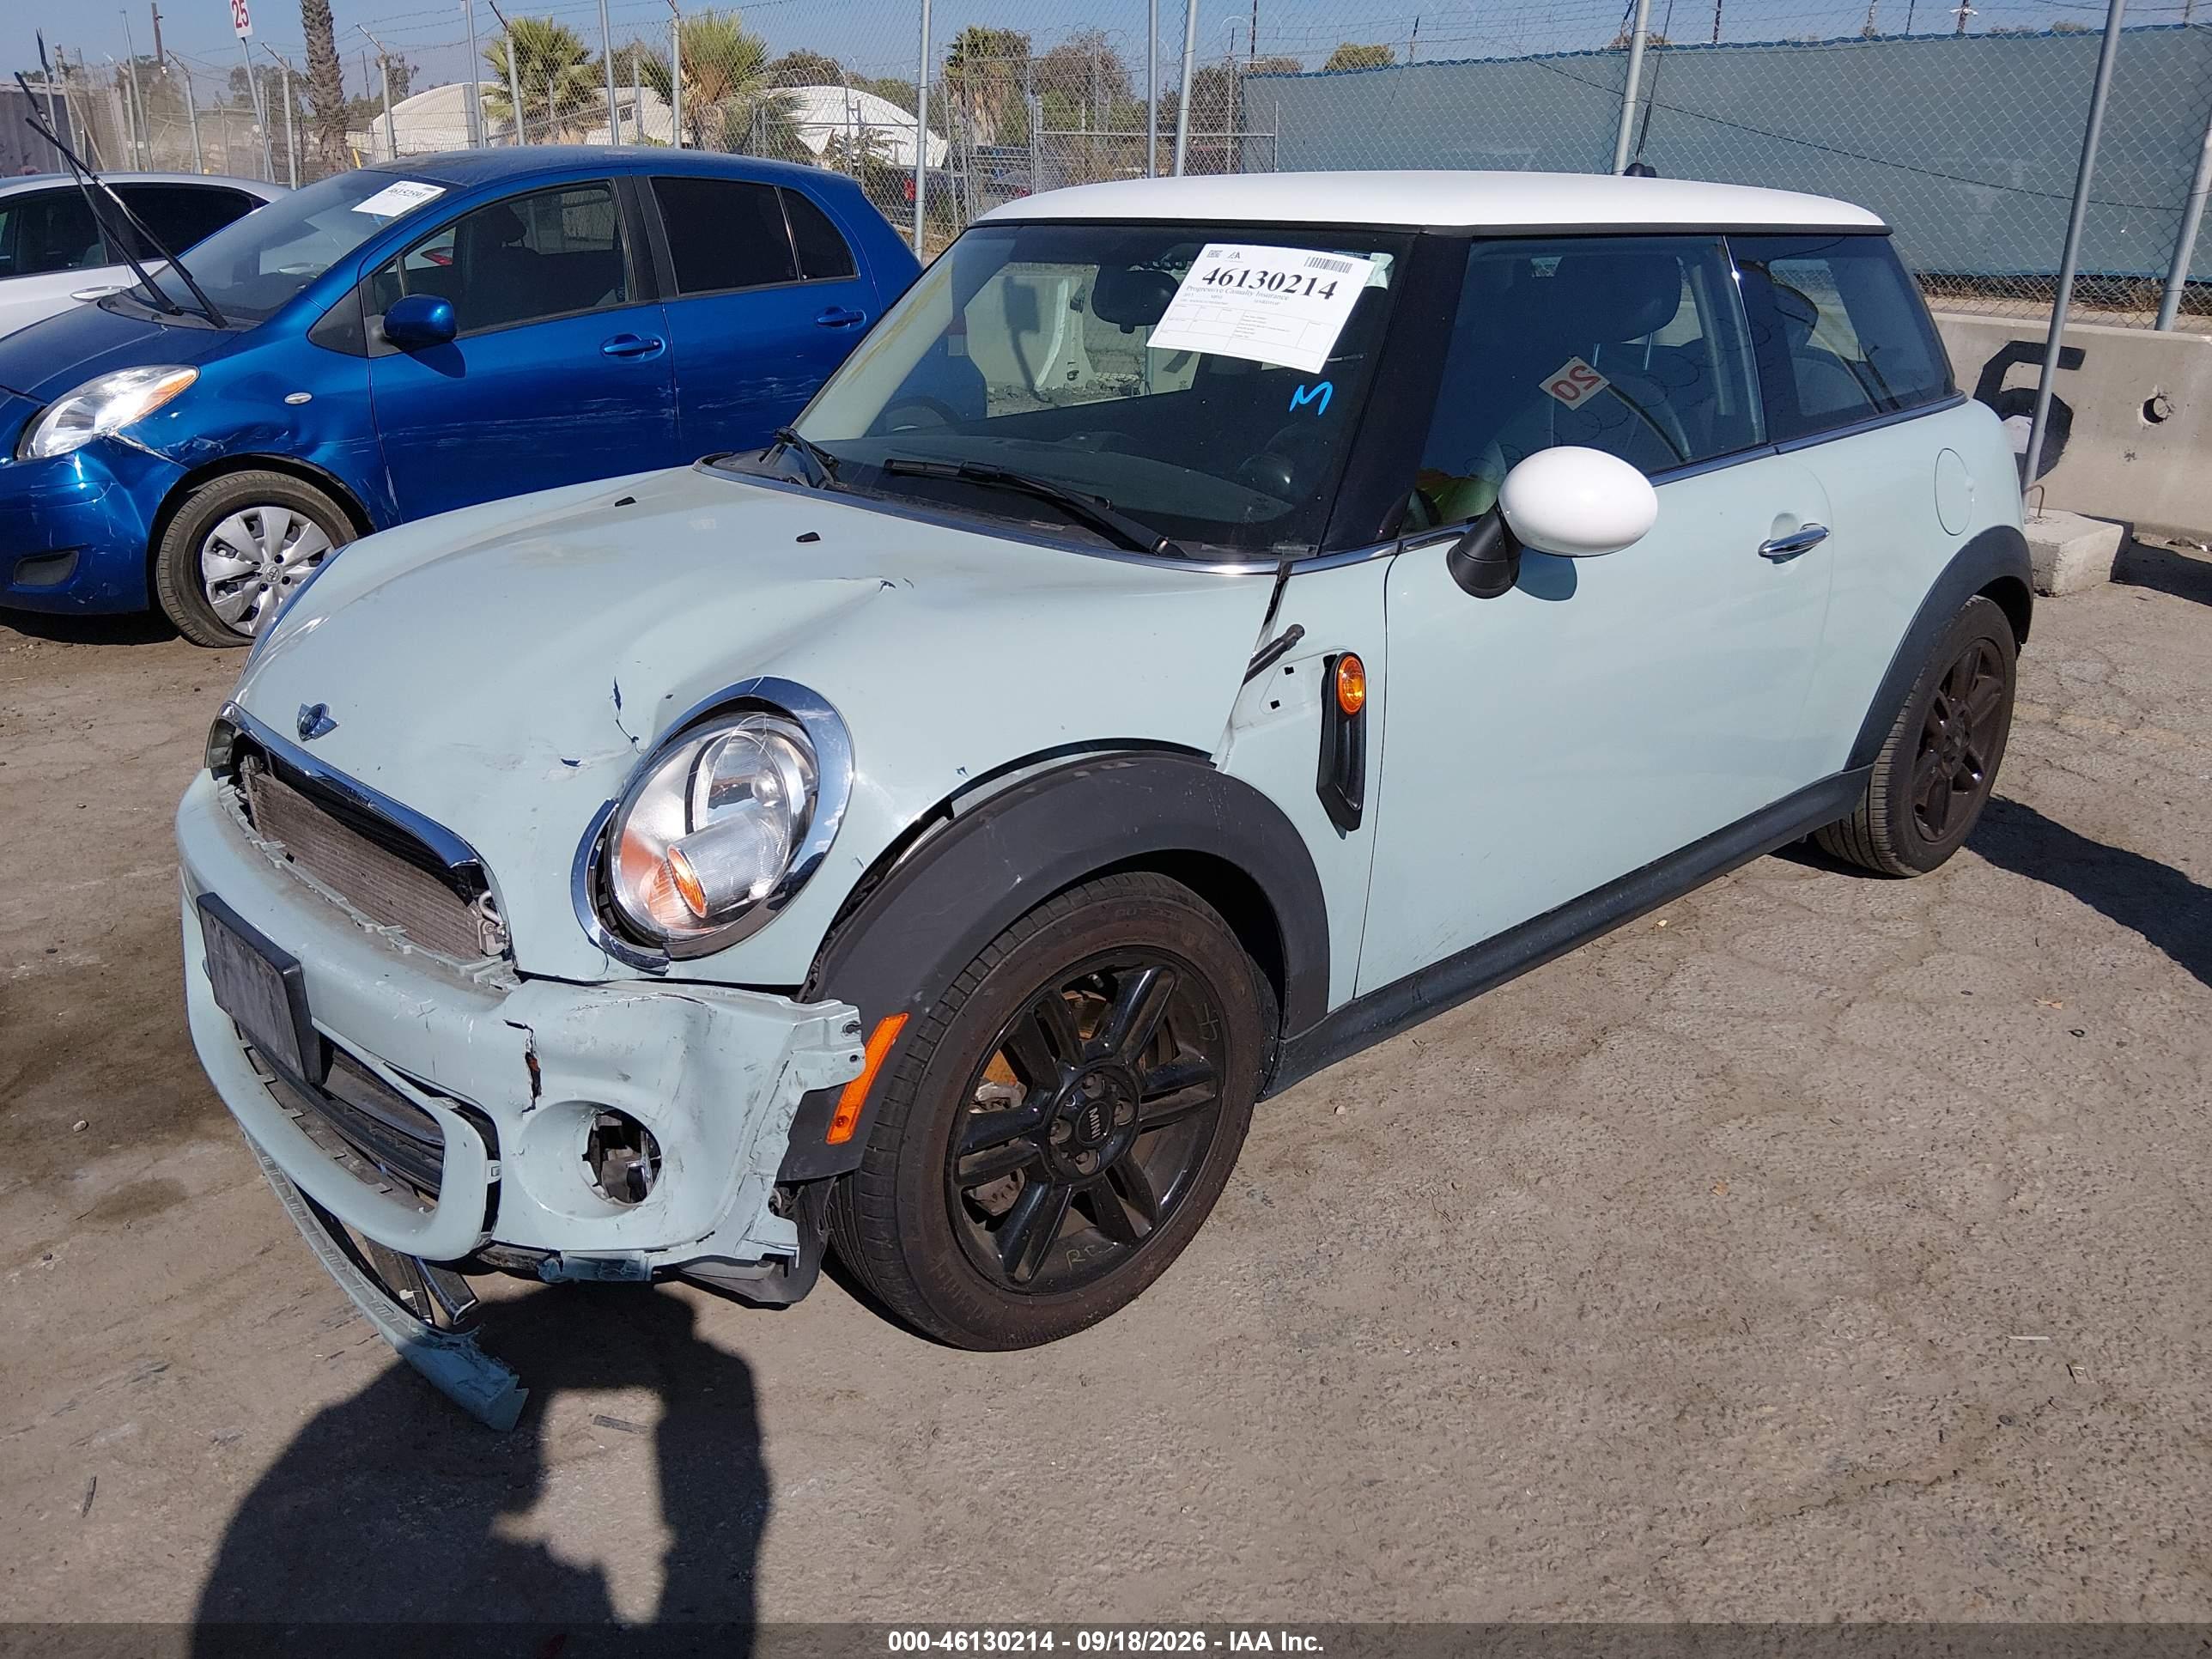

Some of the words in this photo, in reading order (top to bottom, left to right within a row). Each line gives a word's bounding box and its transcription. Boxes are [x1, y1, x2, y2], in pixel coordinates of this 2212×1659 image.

[232, 0, 249, 28] 25
[1186, 285, 1224, 294] Progressive
[1224, 288, 1254, 296] Casualty
[1256, 290, 1289, 301] Insurance
[1202, 267, 1338, 300] 46130214
[1289, 381, 1334, 416] M
[1089, 1107, 1100, 1139] MINI
